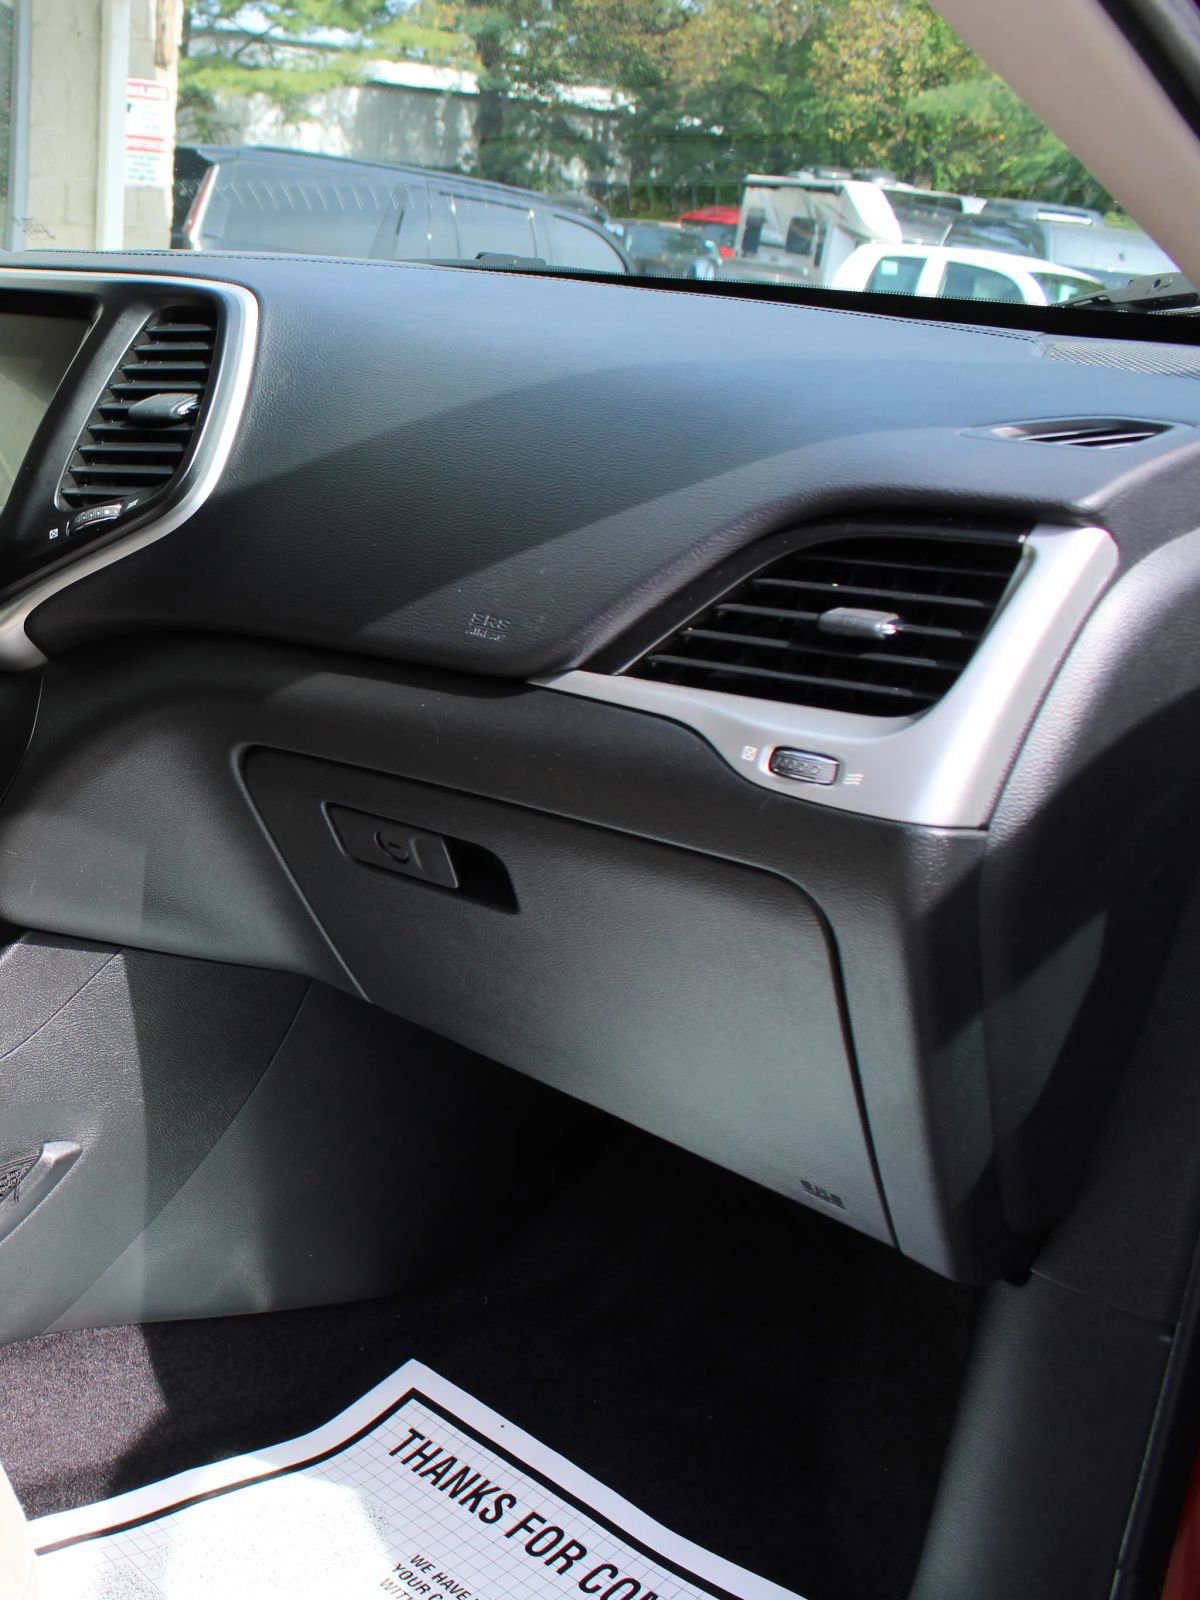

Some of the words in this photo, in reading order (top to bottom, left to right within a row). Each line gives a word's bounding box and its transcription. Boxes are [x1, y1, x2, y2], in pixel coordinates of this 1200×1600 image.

[469, 612, 511, 630] SRS
[388, 1427, 518, 1525] THANKS
[504, 1511, 588, 1576] FOR
[392, 1562, 431, 1595] YOUR
[409, 1554, 436, 1574] WE
[431, 1572, 472, 1600] HAVE
